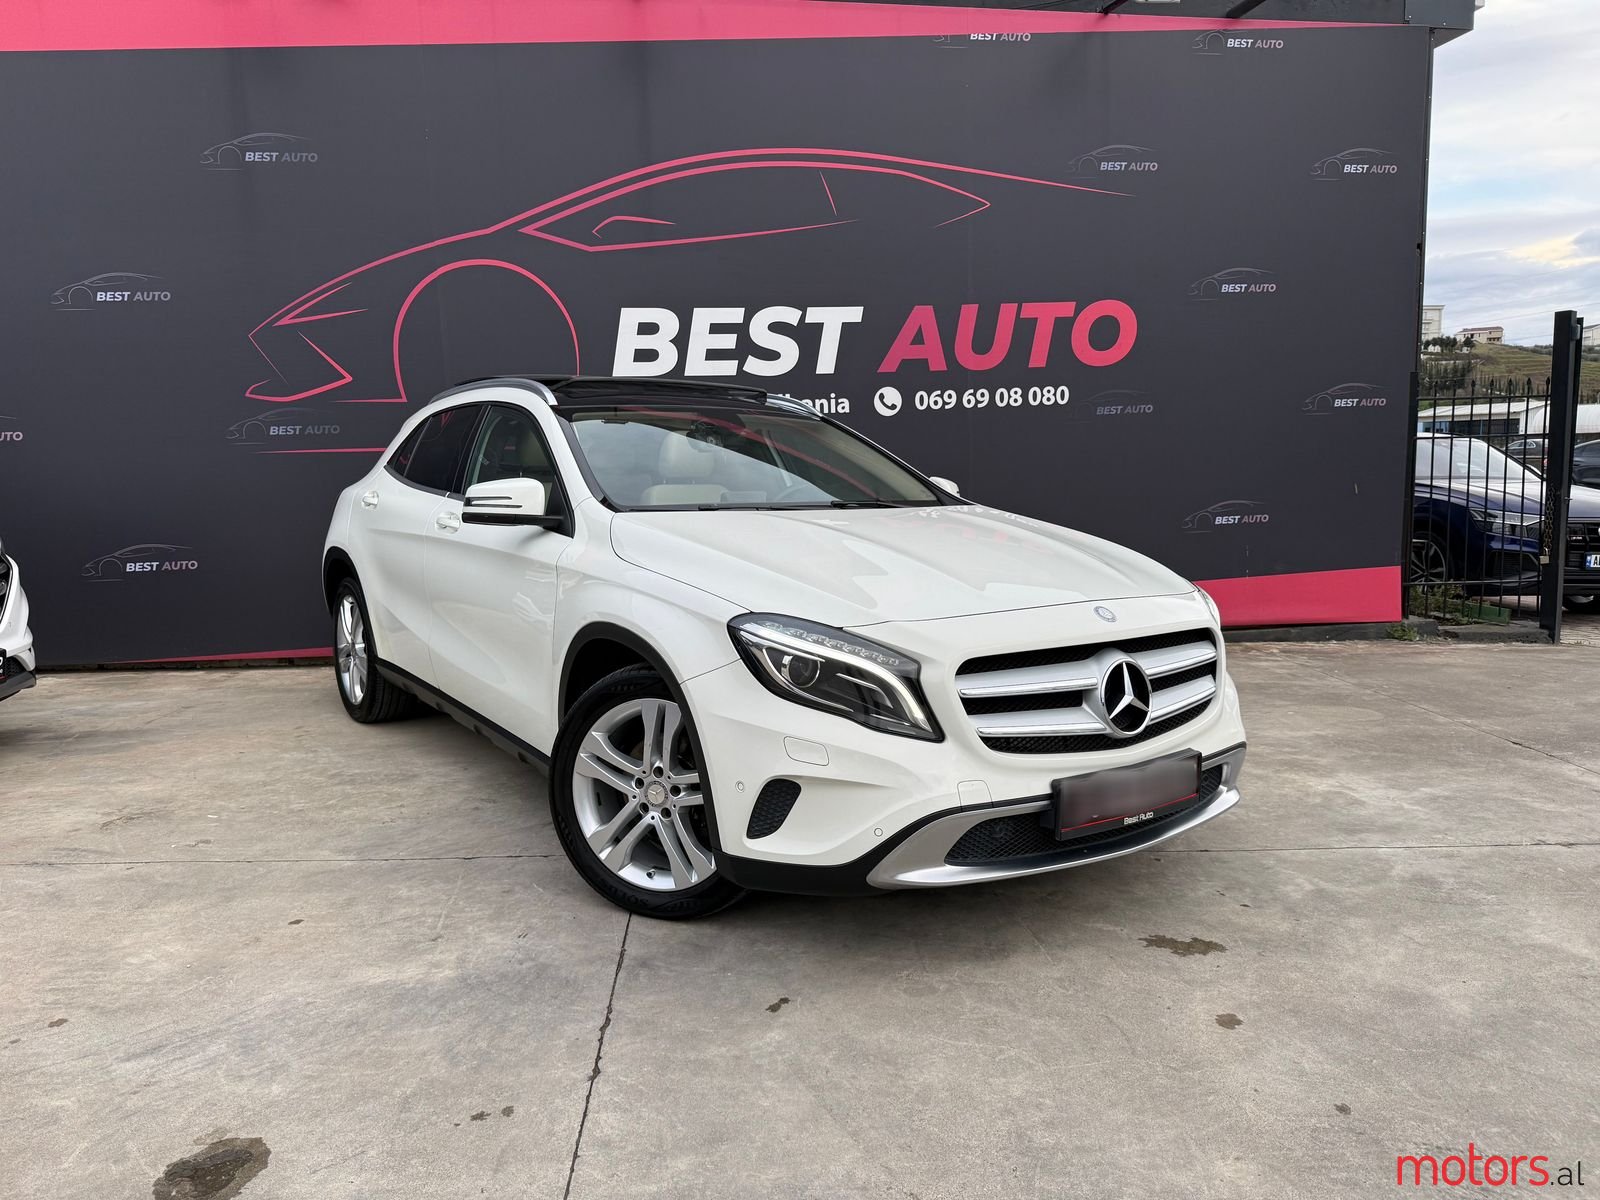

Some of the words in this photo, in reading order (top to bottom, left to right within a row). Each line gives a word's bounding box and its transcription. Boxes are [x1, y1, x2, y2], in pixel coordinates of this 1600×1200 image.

[970, 32, 998, 41] BEST
[1000, 32, 1031, 42] AUTO
[1227, 38, 1253, 48] BEST
[1255, 39, 1284, 49] AUTO
[244, 151, 279, 162] BEST
[281, 152, 318, 163] AUTO
[1100, 161, 1127, 171] BEST
[1128, 161, 1158, 172] AUTO
[1343, 164, 1369, 173] BEST
[1369, 164, 1398, 174] AUTO
[1221, 283, 1247, 293] BEST
[1248, 283, 1277, 293] AUTO
[96, 291, 131, 302] BEST
[132, 291, 171, 301] AUTO
[612, 305, 864, 377] BEST
[877, 299, 1138, 373] AUTO
[914, 389, 957, 411] 069
[962, 388, 990, 409] 69
[995, 387, 1023, 407] 08
[1028, 385, 1070, 406] 080
[1334, 398, 1359, 407] BEST
[1359, 398, 1387, 407] AUTO
[1096, 406, 1123, 416] BEST
[1124, 404, 1154, 414] AUTO
[269, 425, 302, 436] BEST
[304, 424, 341, 435] AUTO
[1214, 515, 1241, 525] BEST
[1241, 514, 1269, 523] AUTO
[126, 561, 159, 572] BEST
[161, 560, 198, 571] AUTO
[1123, 815, 1139, 825] Best
[1139, 811, 1154, 821] Auto
